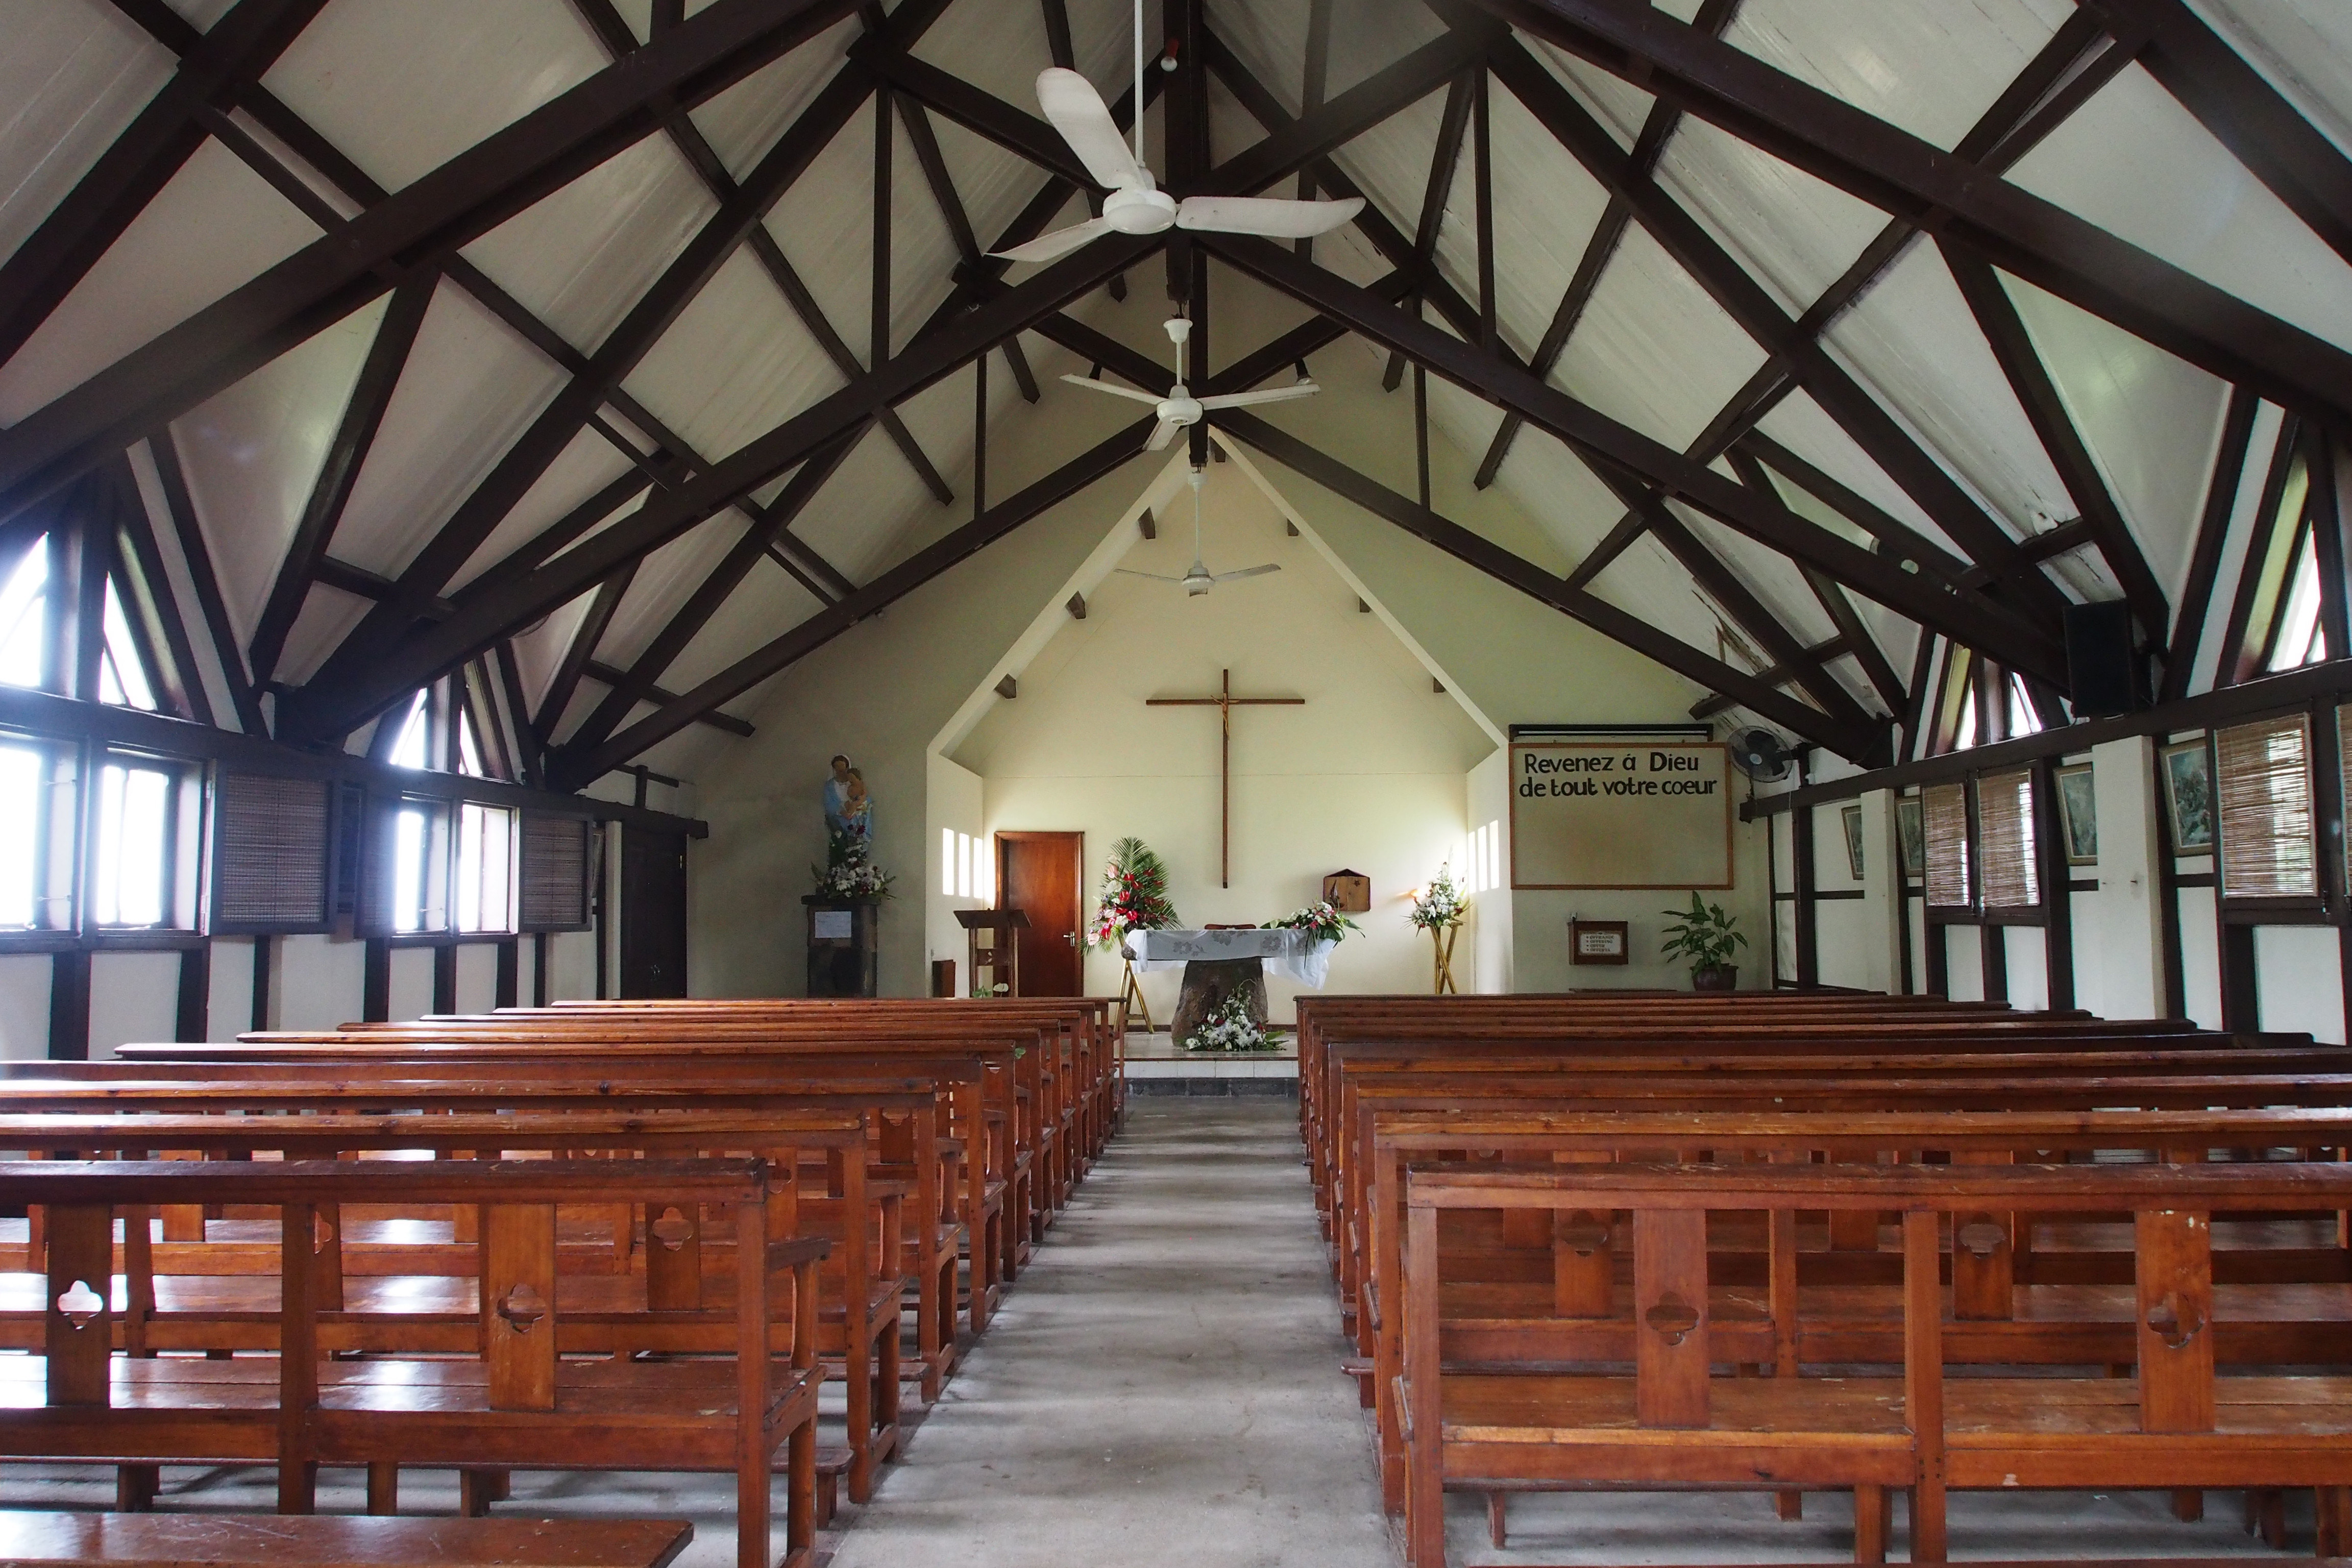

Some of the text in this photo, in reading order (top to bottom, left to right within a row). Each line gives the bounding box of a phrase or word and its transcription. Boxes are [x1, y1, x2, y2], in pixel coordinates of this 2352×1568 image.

[1525, 753, 1614, 773] Revenez
[1650, 752, 1699, 772] Dieu
[1519, 777, 1718, 797] de tout votre coeur
